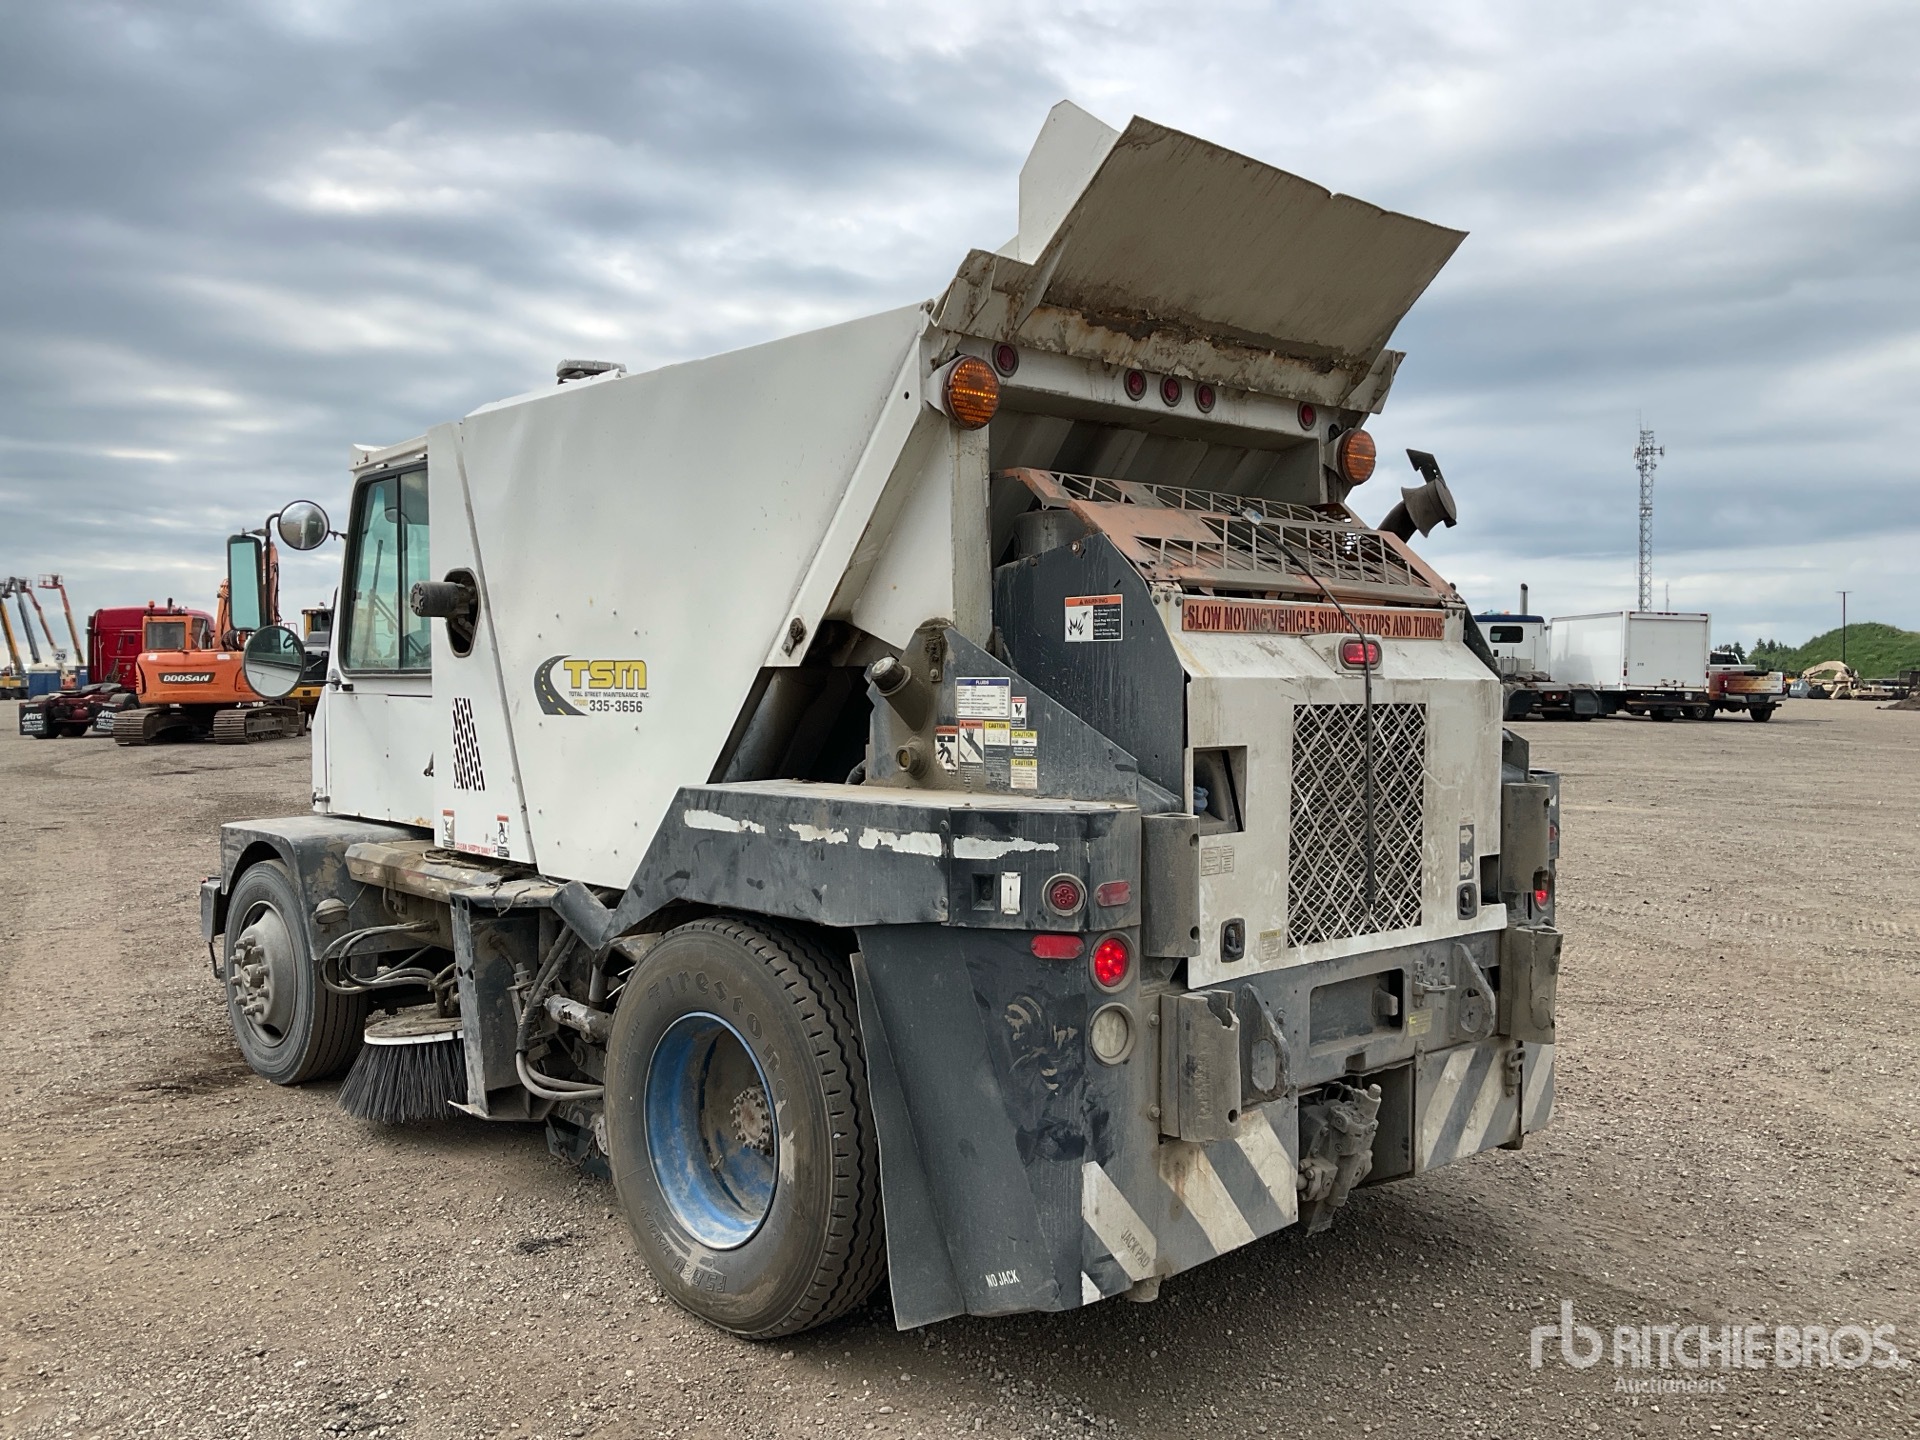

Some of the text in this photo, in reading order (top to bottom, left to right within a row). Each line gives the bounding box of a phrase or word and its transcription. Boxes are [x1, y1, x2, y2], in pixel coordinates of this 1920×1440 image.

[1187, 604, 1444, 638] SLOW MOVING VEHICLE SUDDEN STOPS AND TURNS
[163, 674, 210, 682] DOOSAN
[563, 659, 647, 690] TSM
[589, 699, 643, 712] 335-3656
[1120, 1230, 1150, 1268] JACK PAD
[985, 1270, 1020, 1288] NO JACK
